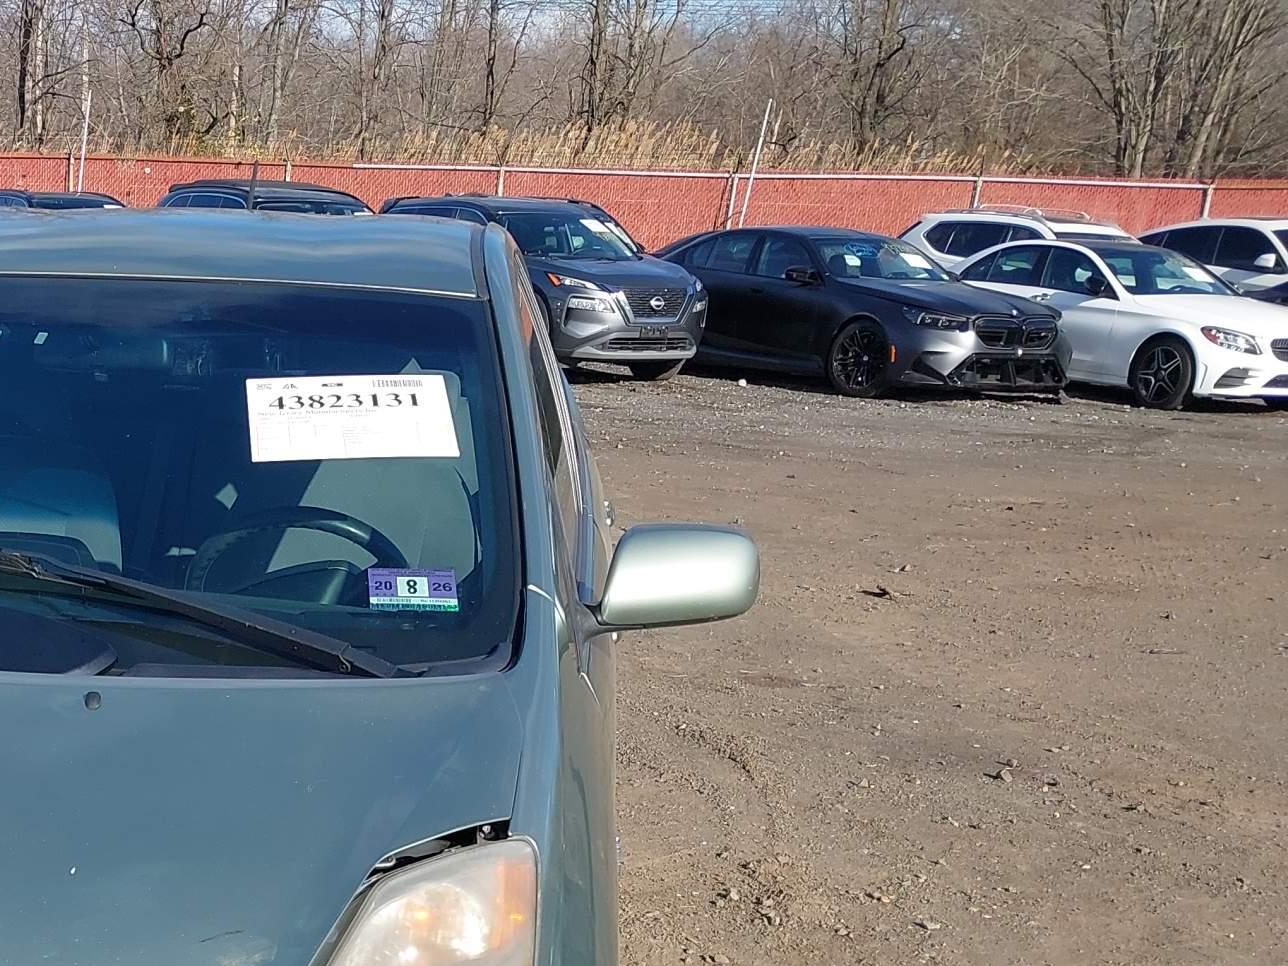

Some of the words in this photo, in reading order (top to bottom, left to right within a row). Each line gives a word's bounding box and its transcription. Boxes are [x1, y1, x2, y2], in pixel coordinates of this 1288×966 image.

[269, 393, 421, 411] 43823131
[374, 580, 393, 591] 20
[406, 579, 418, 595] 8
[432, 582, 453, 592] 26
